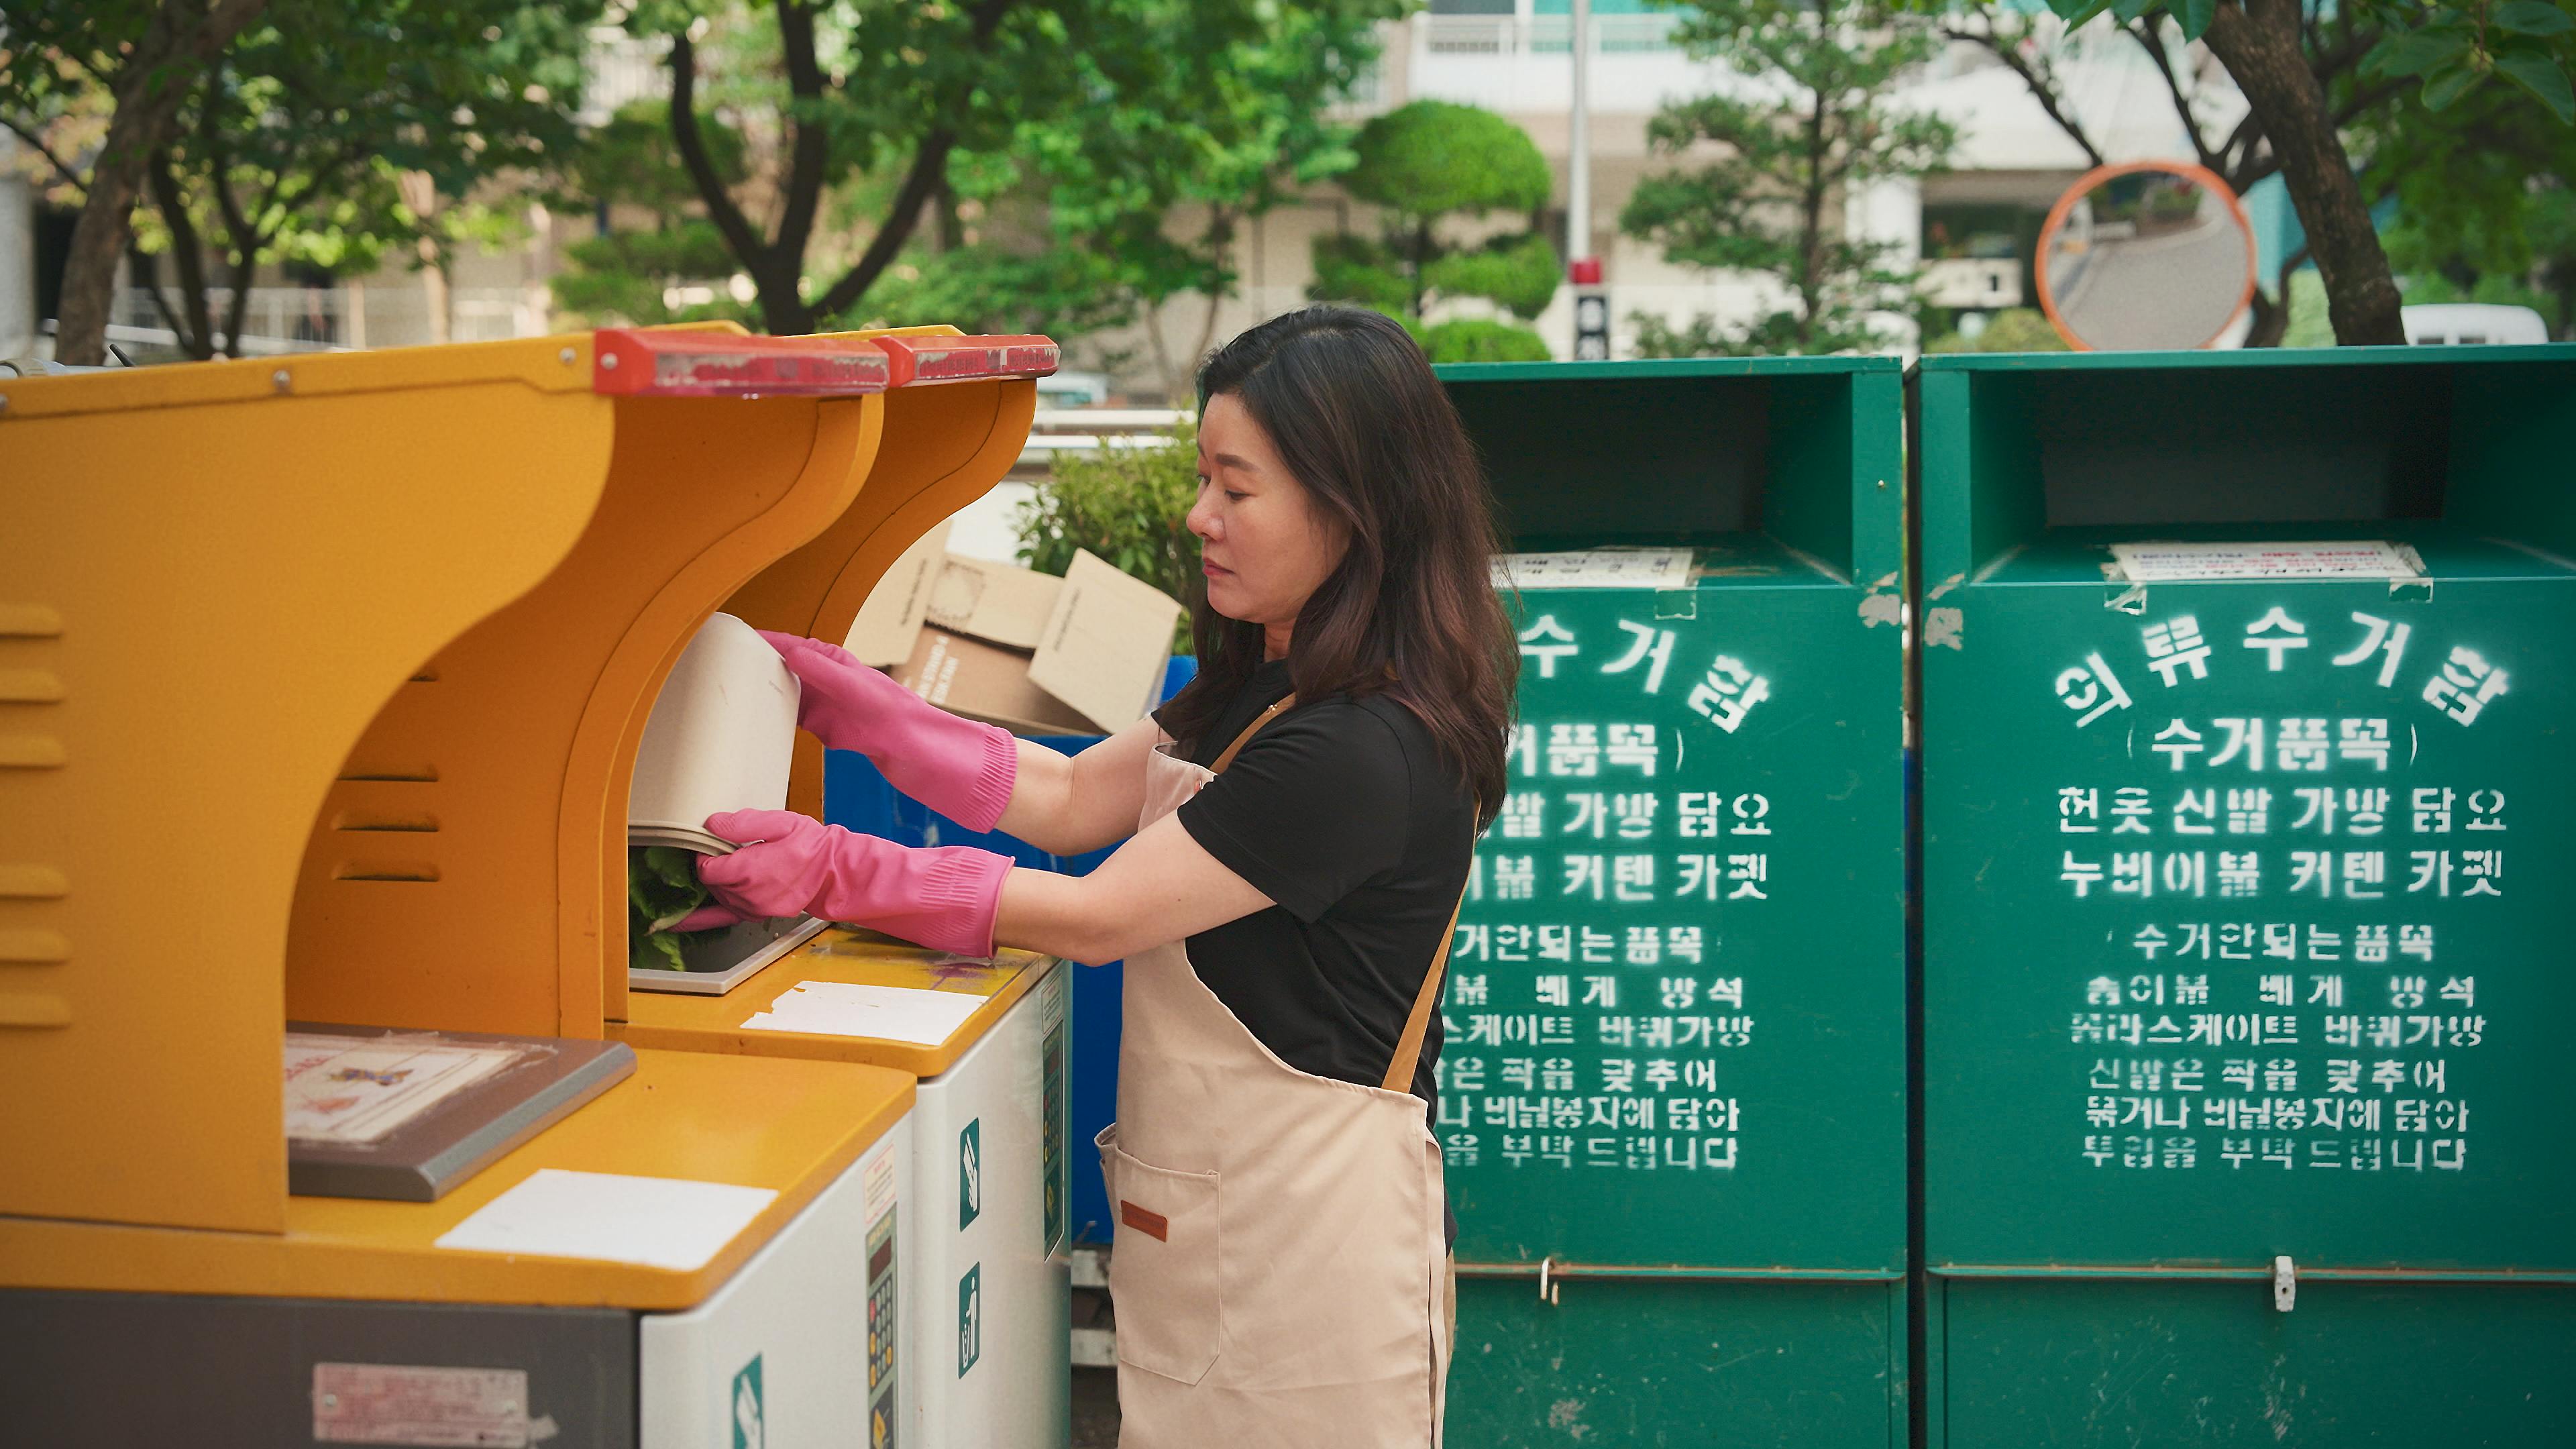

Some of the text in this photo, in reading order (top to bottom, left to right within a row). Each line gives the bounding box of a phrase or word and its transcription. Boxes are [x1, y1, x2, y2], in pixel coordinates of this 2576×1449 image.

[1478, 792, 1771, 839] 발 가방 담요
[2059, 787, 2506, 835] 헌옷 신발 가방 담요
[1564, 855, 1654, 901] 커텐
[1676, 854, 1767, 900] 카펫
[2061, 851, 2502, 898] 누비이불 커텐 카펫
[1660, 977, 1742, 1009] 방석
[2391, 977, 2473, 1008] 방석
[1599, 1016, 1754, 1047] 바퀴가방
[2326, 1016, 2485, 1047] 바퀴가방
[1503, 1059, 1573, 1090] 짝을
[2091, 1060, 2203, 1091] 신발은
[2222, 1059, 2297, 1091] 짝을
[1485, 1096, 1654, 1129] 비닐봉지에
[1668, 1098, 1739, 1131] 담아
[2086, 1096, 2469, 1132] 묶거나 비닐봉지에 담아
[2082, 1136, 2195, 1168] 투입을
